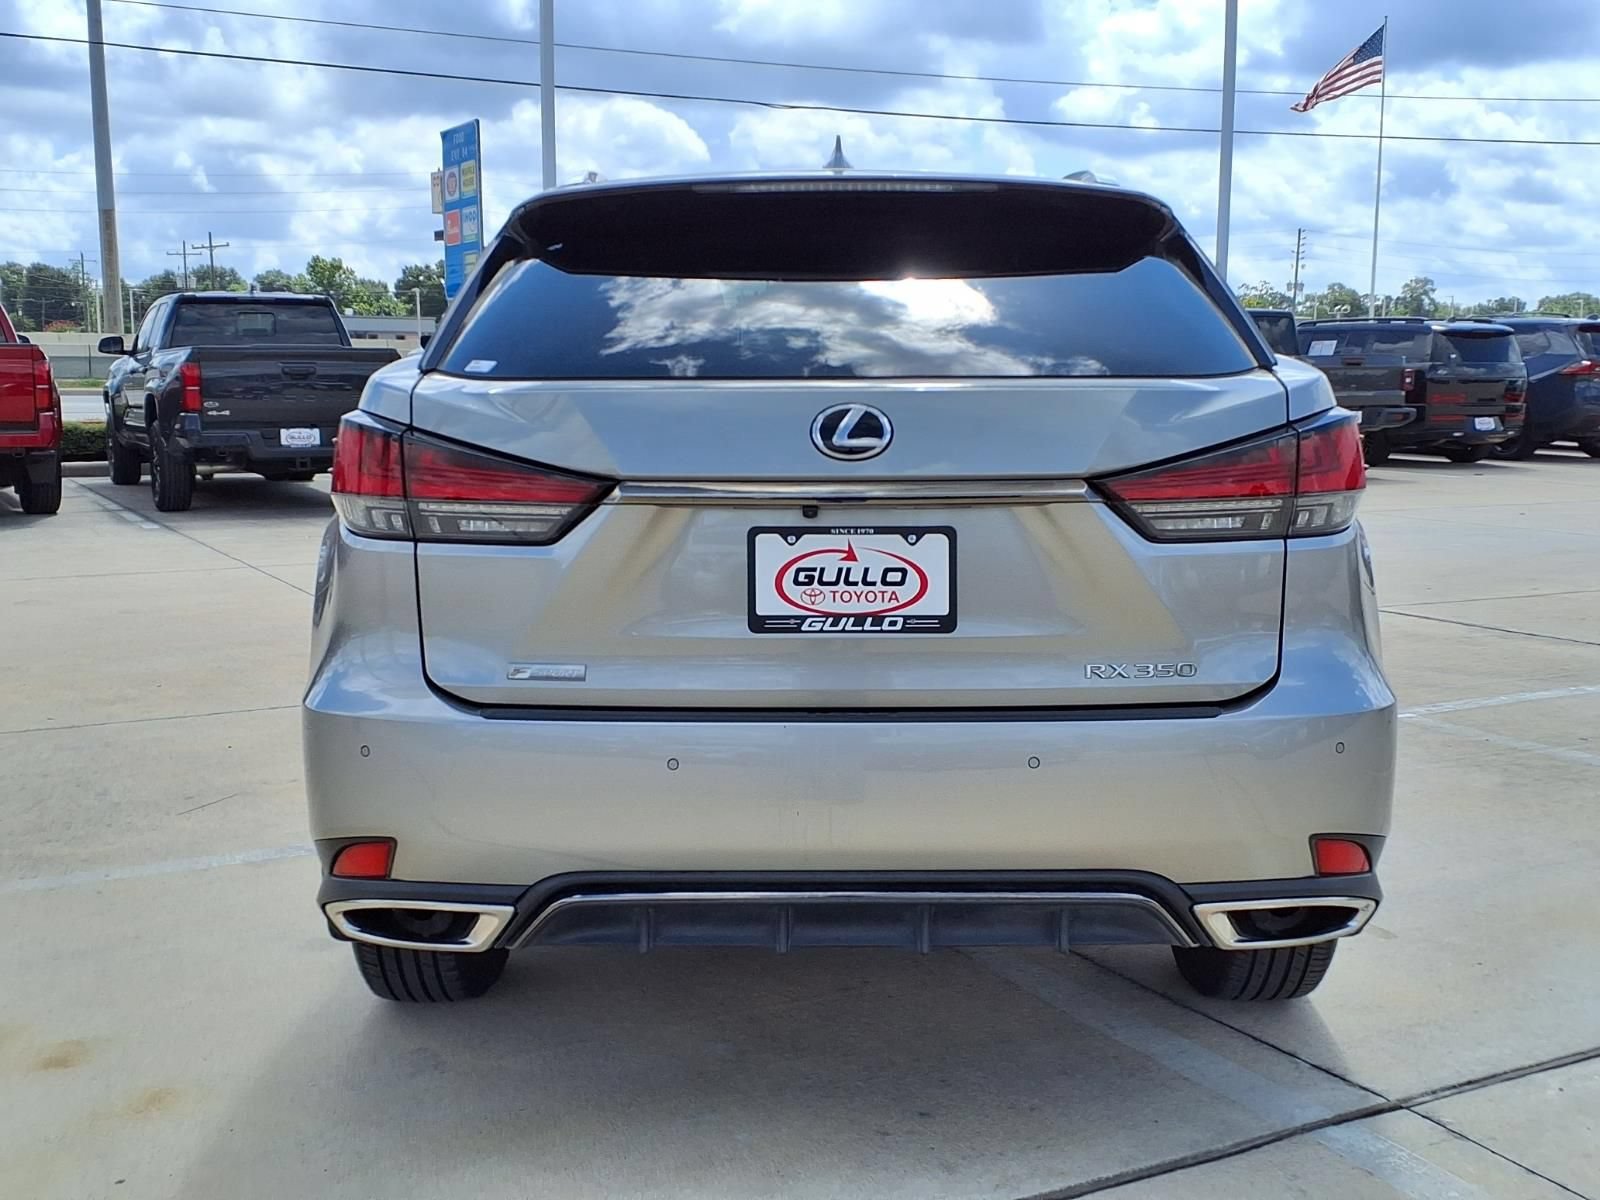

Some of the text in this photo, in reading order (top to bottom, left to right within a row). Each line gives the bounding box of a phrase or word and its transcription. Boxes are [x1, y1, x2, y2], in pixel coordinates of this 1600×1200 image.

[792, 567, 908, 587] GULLO
[829, 590, 900, 603] TOYOTA
[801, 617, 904, 631] GULLO
[1084, 662, 1198, 679] RX 350
